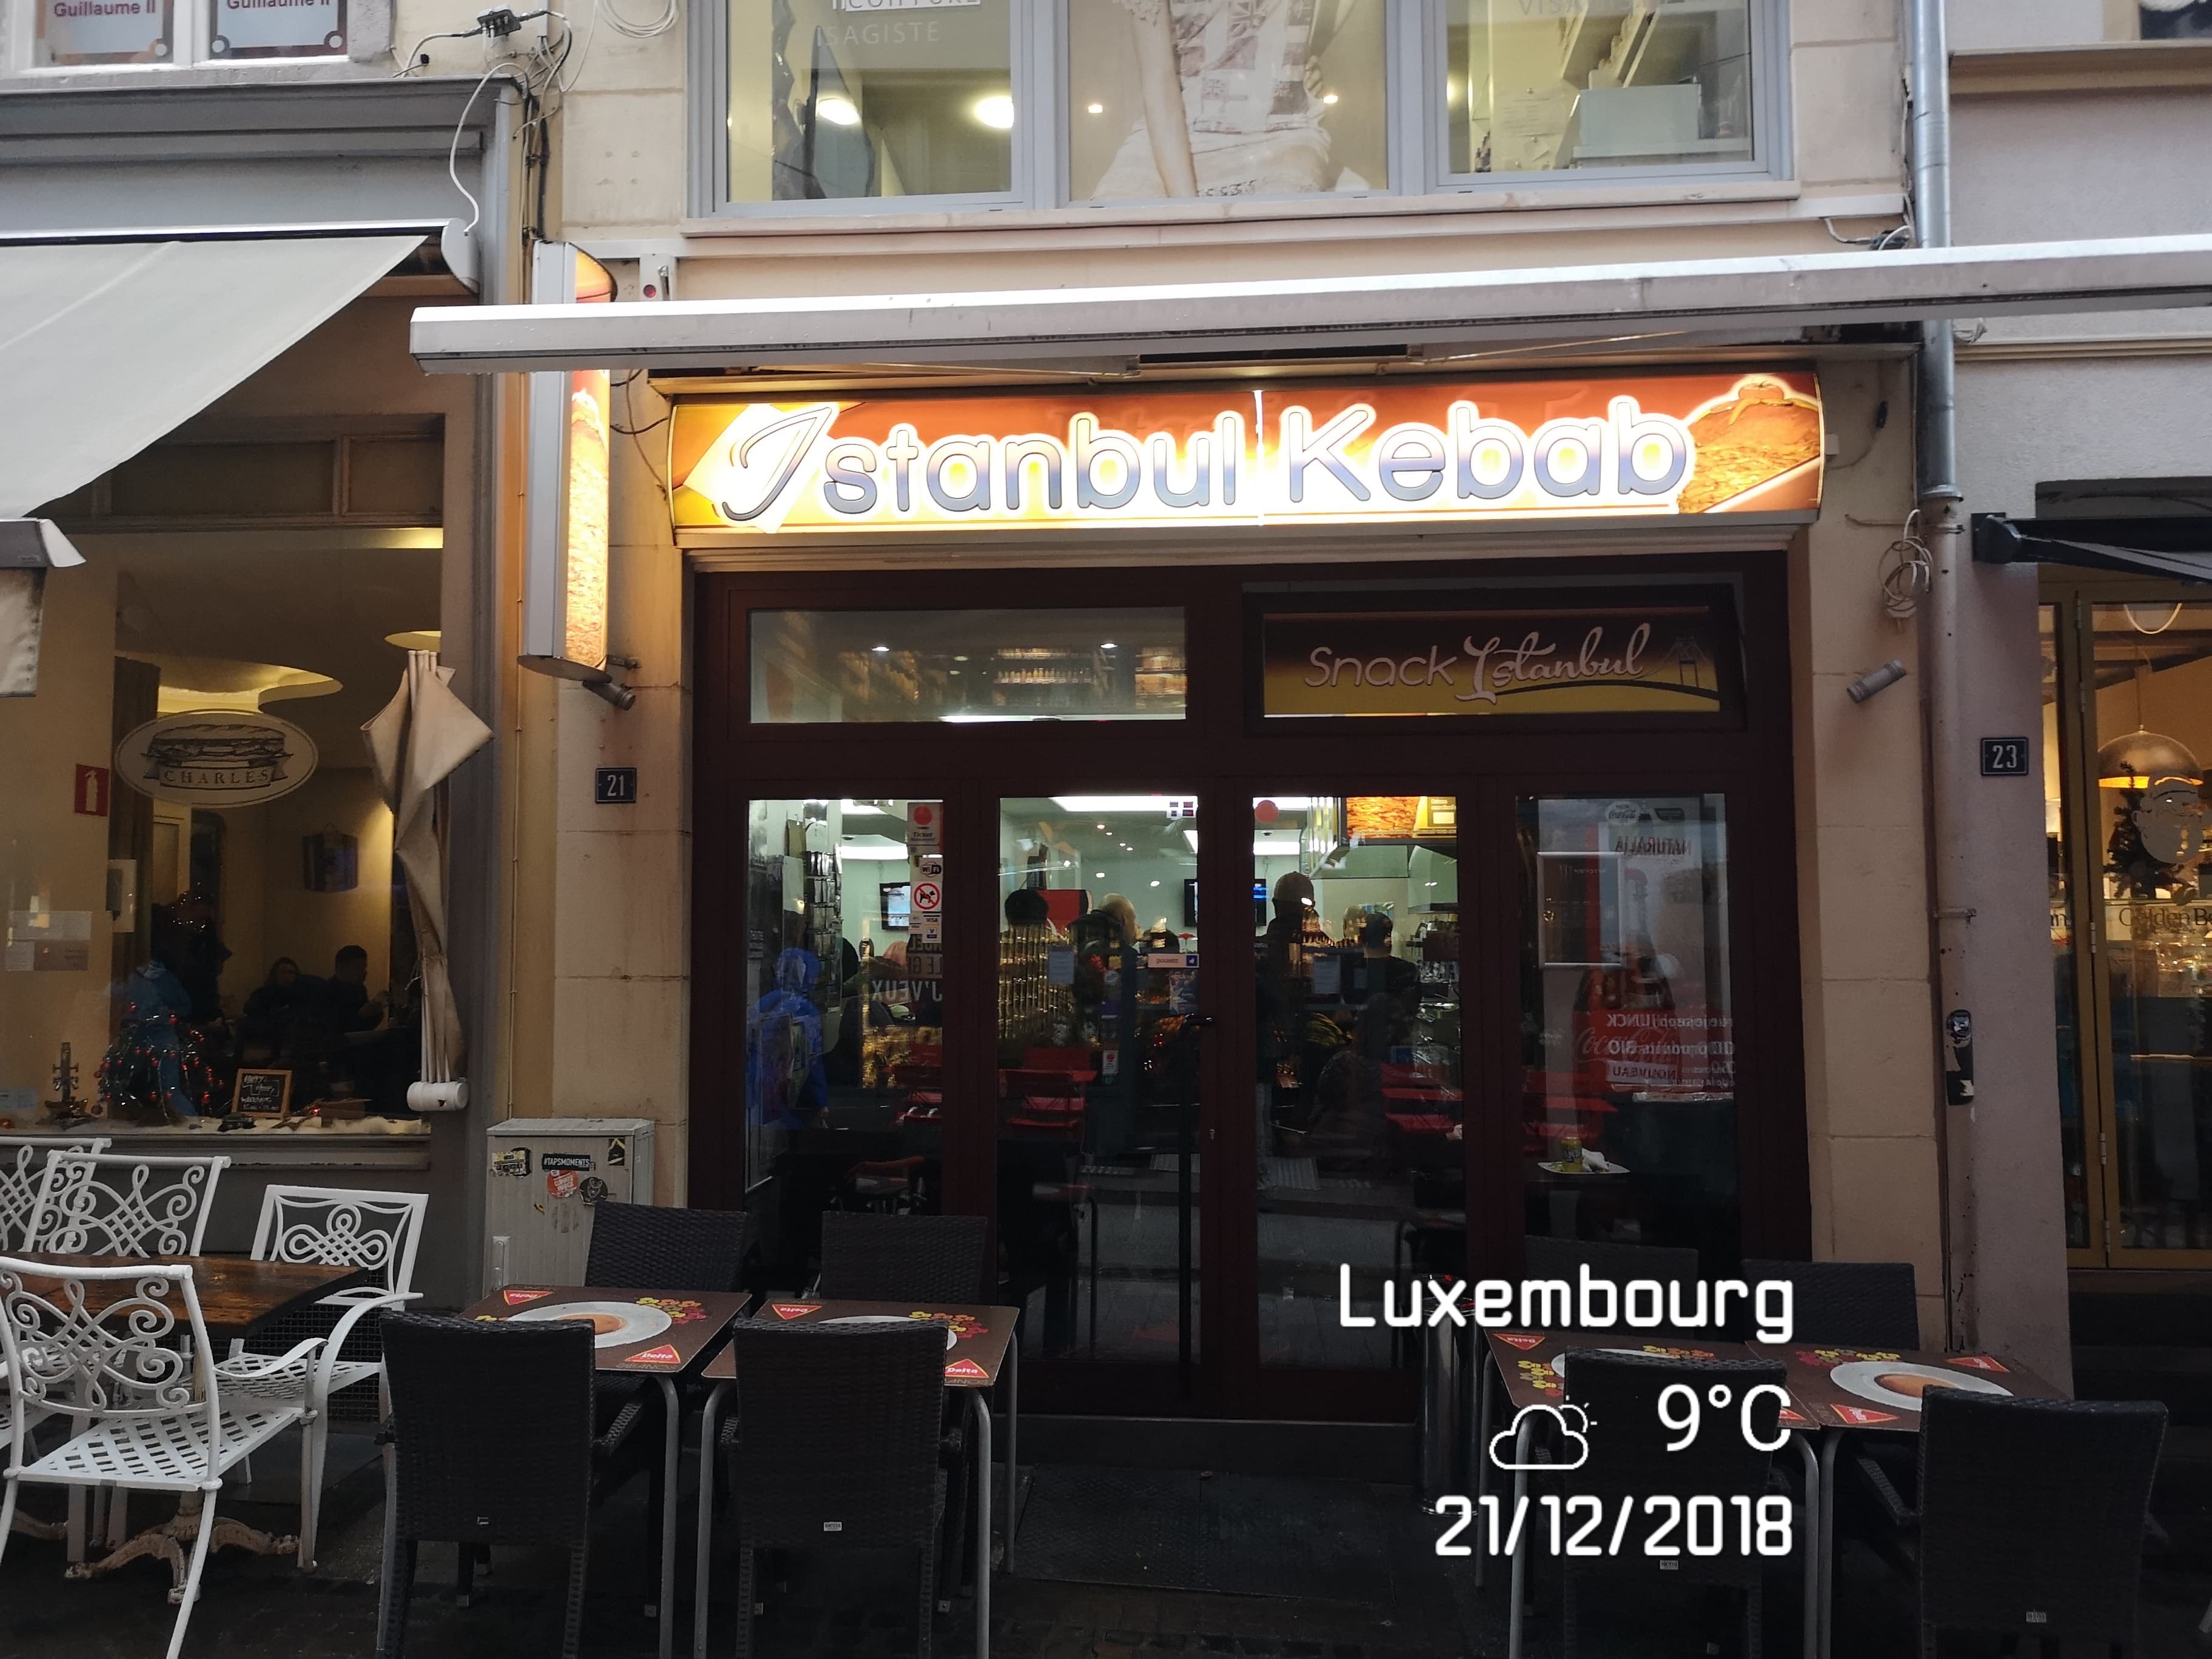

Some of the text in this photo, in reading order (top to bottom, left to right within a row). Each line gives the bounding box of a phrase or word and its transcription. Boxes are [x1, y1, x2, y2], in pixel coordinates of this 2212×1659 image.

[54, 2, 140, 17] Guillaume
[720, 401, 1688, 521] Istanbul Kebab
[1304, 622, 1651, 705] Snack Istanbul
[1992, 745, 2017, 769] 23
[164, 769, 269, 784] CHARLES
[607, 774, 625, 797] 21
